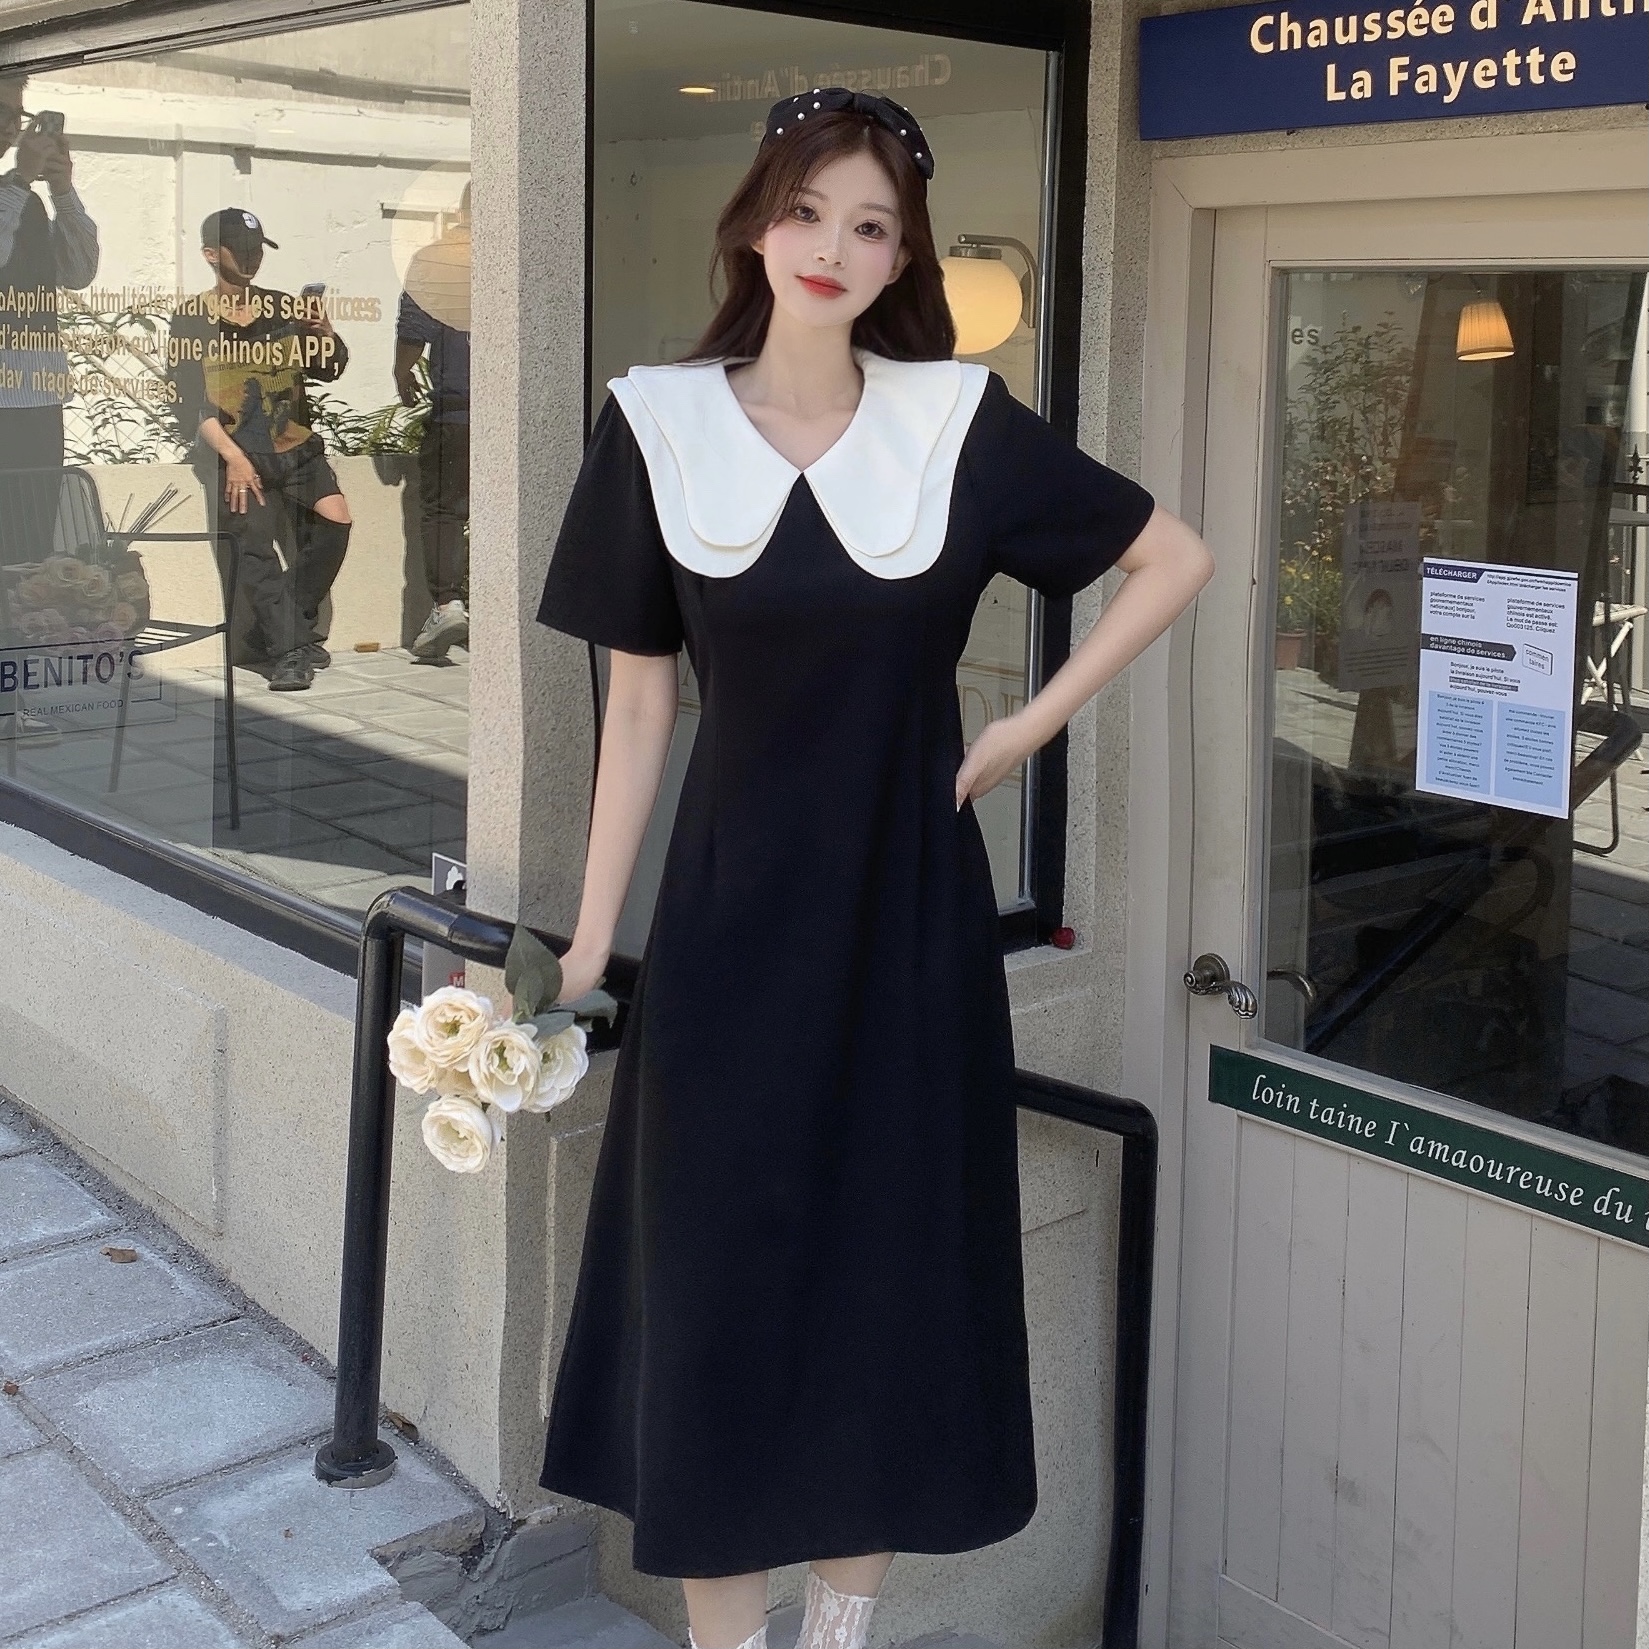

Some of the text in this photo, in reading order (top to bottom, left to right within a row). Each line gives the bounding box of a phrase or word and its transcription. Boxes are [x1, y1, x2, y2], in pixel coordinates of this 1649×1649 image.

[1251, 0, 1455, 53] Chaussée
[1326, 46, 1577, 104] La Fayette
[245, 287, 275, 319] les
[158, 330, 203, 367] ligne
[208, 332, 283, 366] chinois
[288, 335, 340, 376] APP,
[1426, 566, 1476, 579] TÉLÉCHARGER
[1429, 642, 1465, 653] davantage
[1439, 636, 1455, 644] ligne
[1457, 639, 1482, 647] chinois
[0, 650, 145, 693] BENITO'S
[23, 699, 125, 717] REAL MEXICAN FOOD
[1252, 1074, 1301, 1114] loin
[1309, 1098, 1377, 1138] taine
[1593, 1187, 1634, 1224] du
